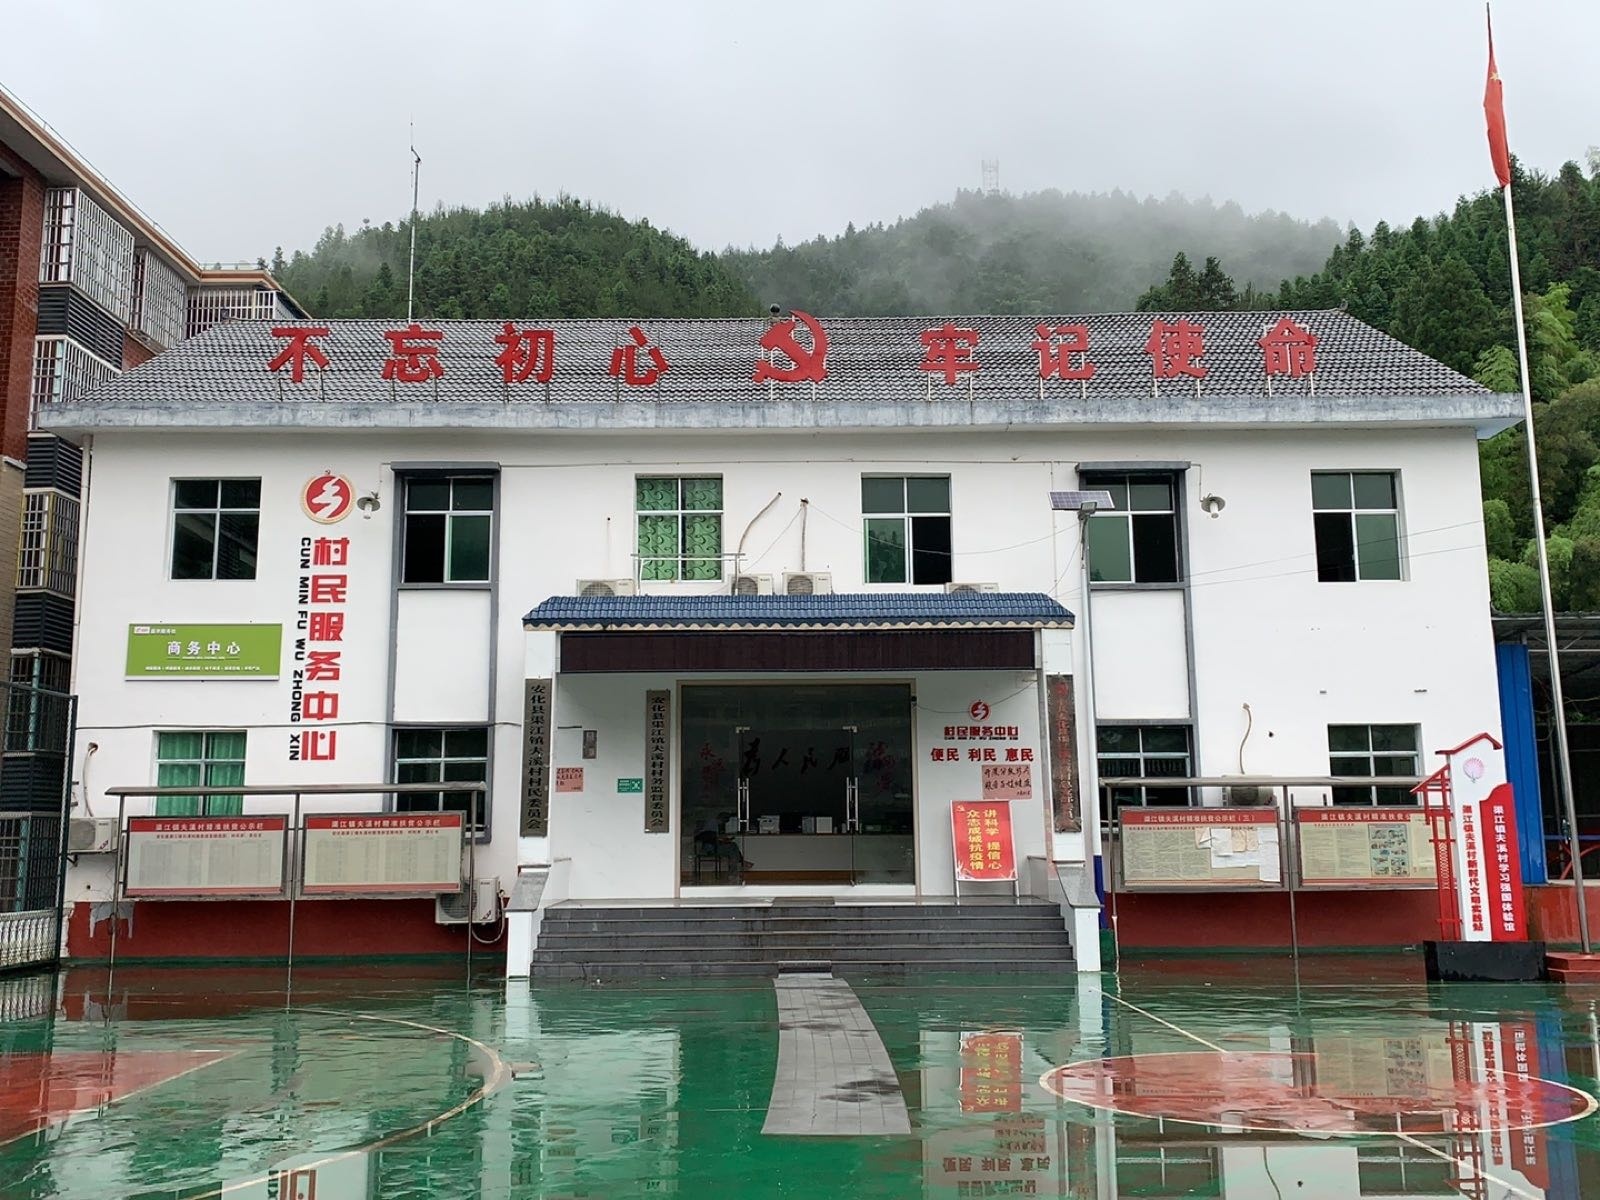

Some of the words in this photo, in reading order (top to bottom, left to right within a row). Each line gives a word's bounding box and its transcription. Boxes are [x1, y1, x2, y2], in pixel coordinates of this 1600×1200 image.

[267, 322, 669, 385] 不忘初心
[919, 317, 1317, 385] 牢记使命
[300, 537, 311, 569] CUN
[298, 576, 309, 605] MIN
[296, 610, 308, 630] FU
[167, 641, 241, 655] 商务中心
[294, 638, 305, 661] WU
[301, 536, 350, 761] 村民服务中心
[290, 670, 303, 722] ZHONG
[943, 726, 1019, 737] 村民服务中心
[289, 734, 300, 761] XIN
[931, 748, 960, 762] 便民
[968, 748, 997, 762] 利民
[1005, 748, 1034, 762] 惠民
[966, 809, 984, 870] 众志成城抗疫情
